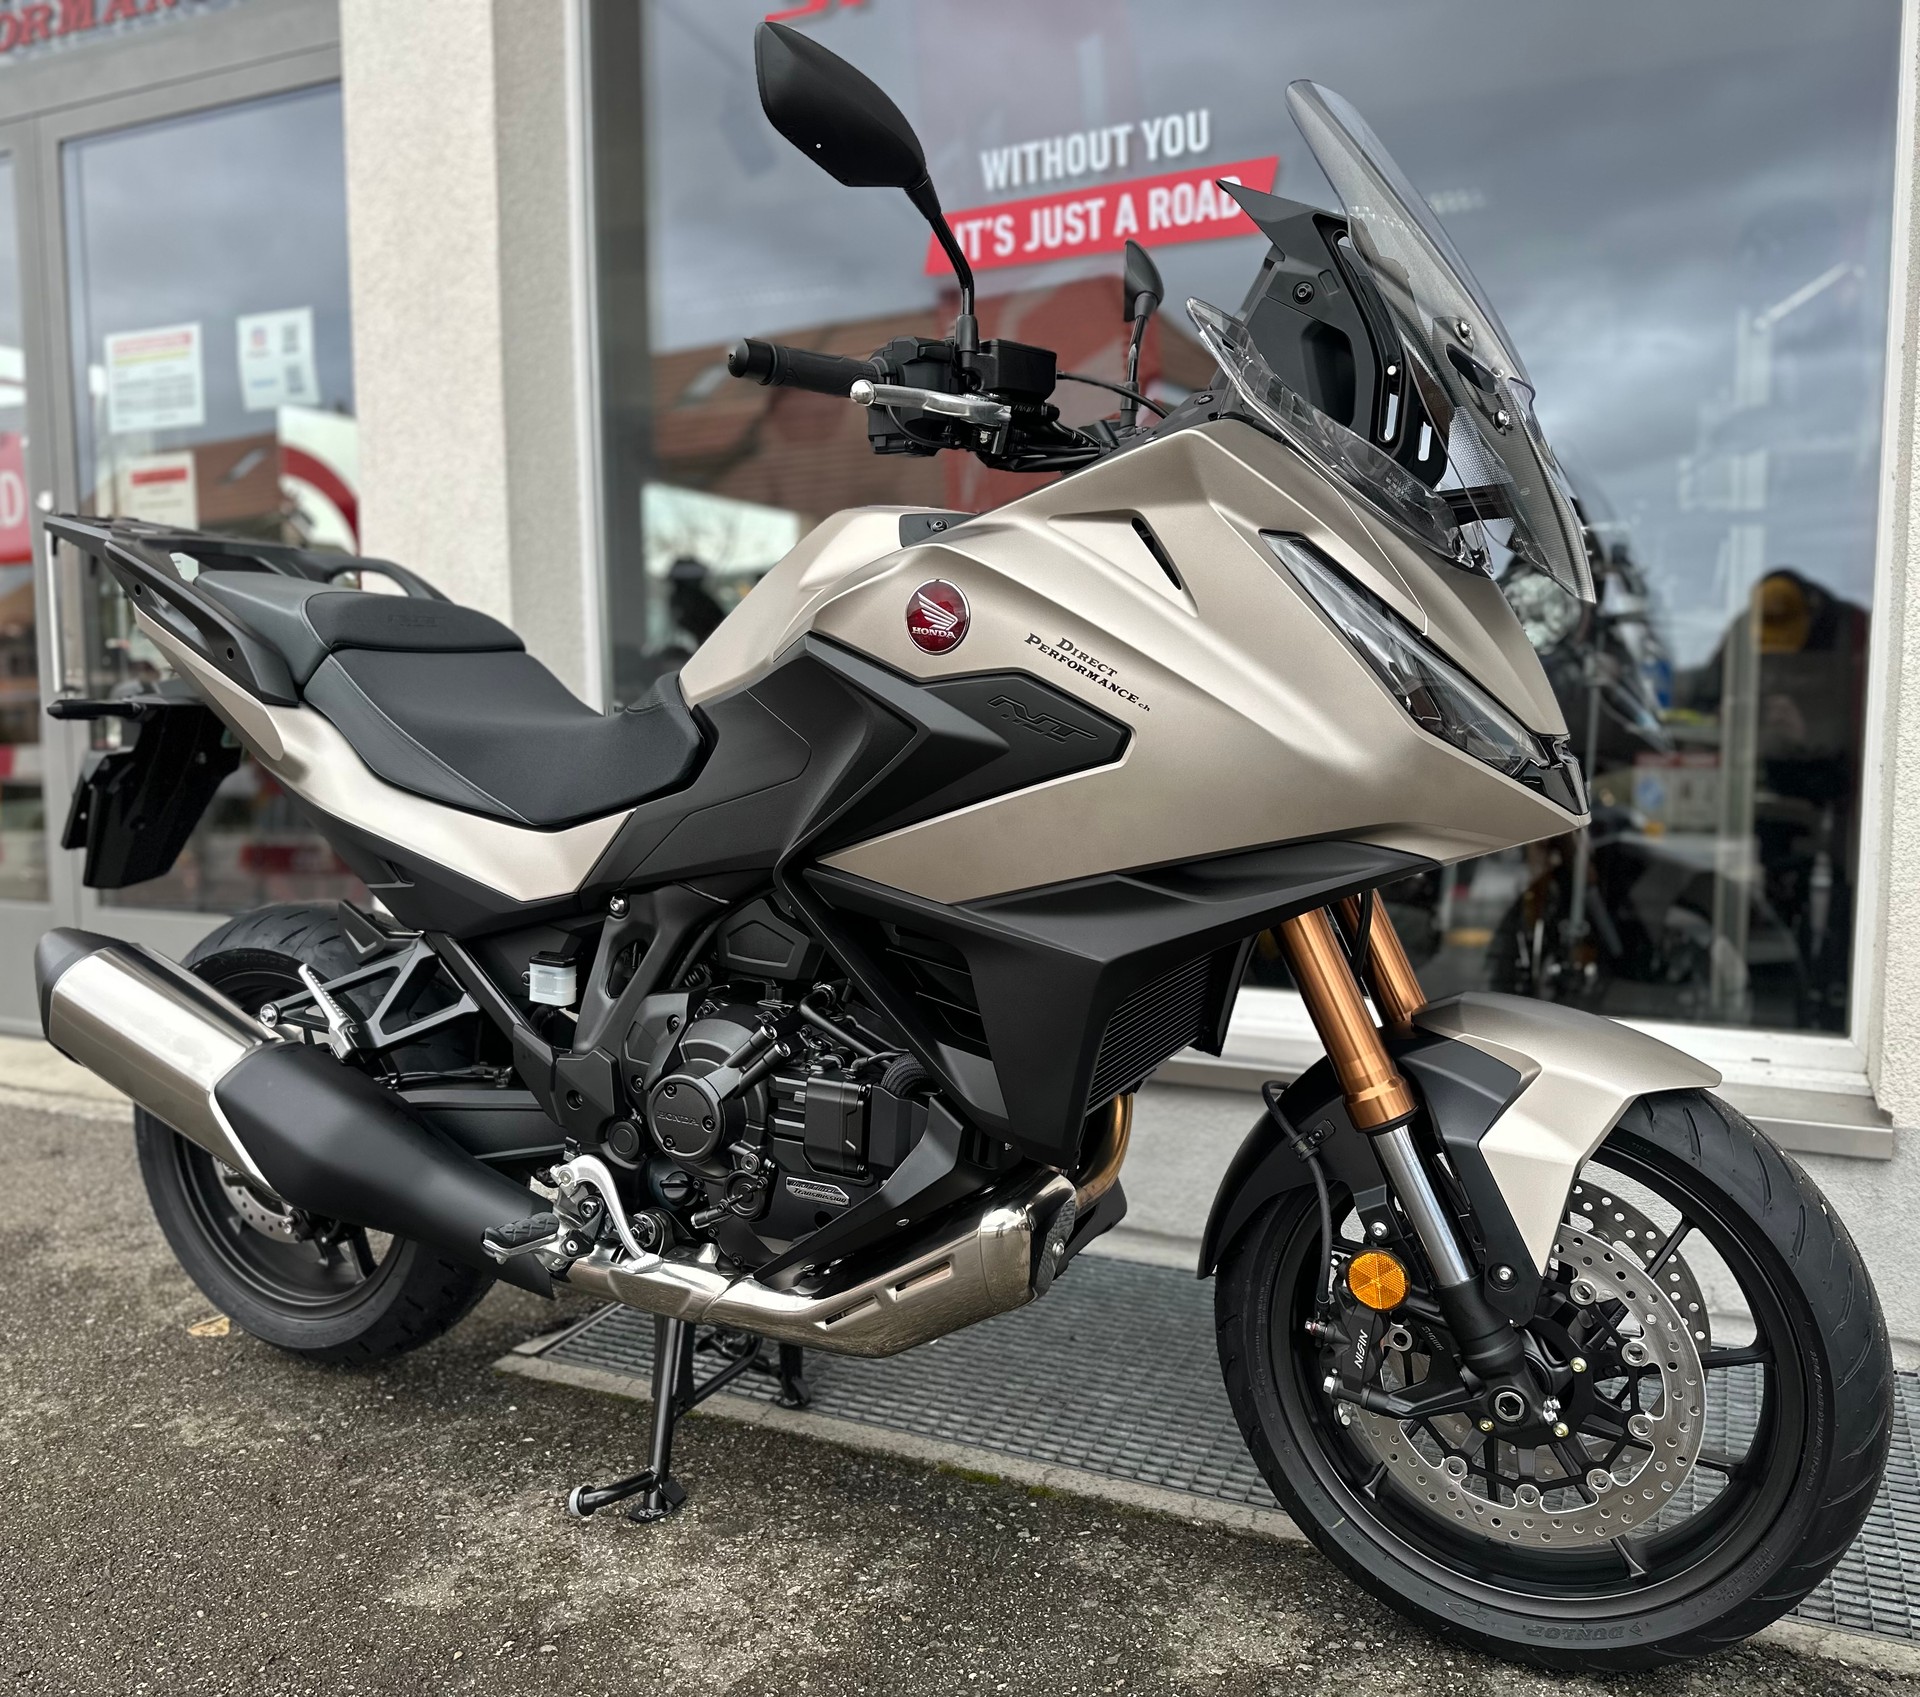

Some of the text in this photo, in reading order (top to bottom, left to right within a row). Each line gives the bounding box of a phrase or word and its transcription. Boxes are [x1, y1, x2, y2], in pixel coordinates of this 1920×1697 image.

[981, 109, 1210, 192] WITHOUT YOU
[1024, 198, 1106, 252] JUST
[1114, 194, 1139, 237] A
[912, 626, 957, 639] HONDA
[1056, 637, 1118, 677] DIRECT
[656, 1110, 700, 1127] HONDA
